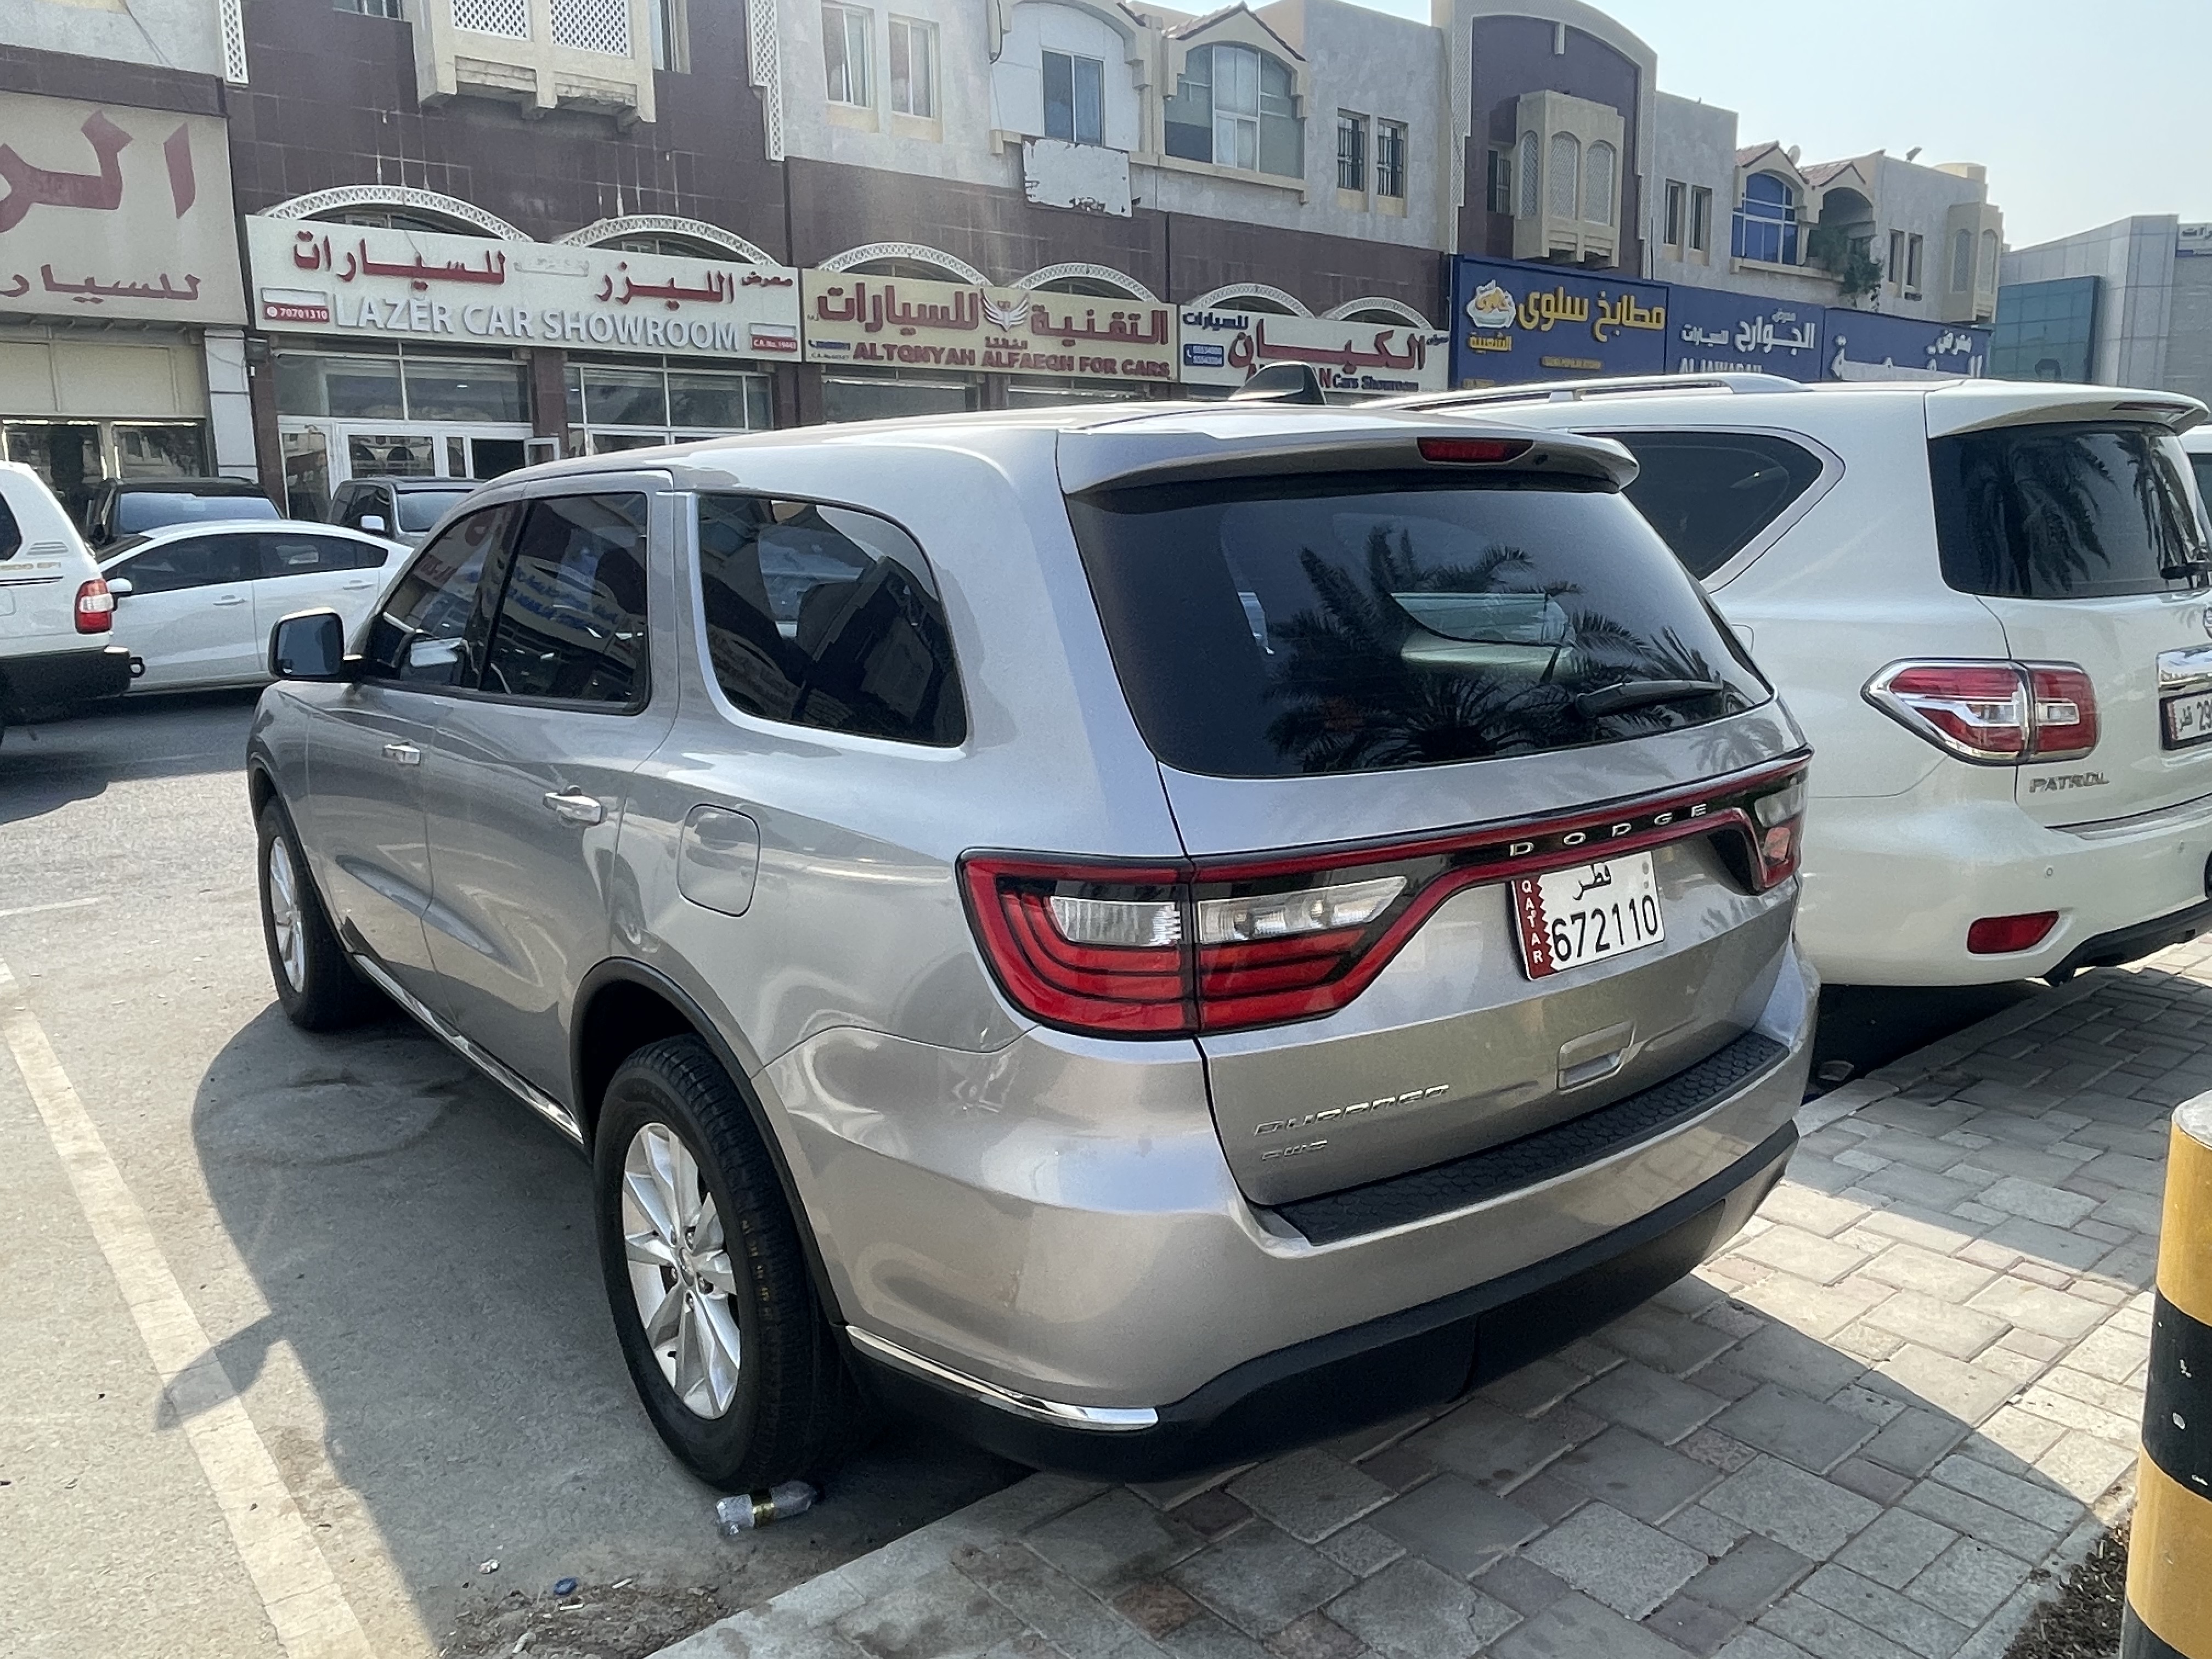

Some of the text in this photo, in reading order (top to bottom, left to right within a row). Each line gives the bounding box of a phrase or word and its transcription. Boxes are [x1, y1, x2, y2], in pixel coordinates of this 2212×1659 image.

[0, 264, 201, 304] للسيار
[293, 230, 793, 311] معرض الليزر للسيارات
[280, 307, 328, 320] 70701310
[334, 293, 740, 352] LAZER CAR SHOWROOM
[817, 282, 1169, 347] التقنية للسيارات
[1183, 312, 1249, 331] للسيارات
[1518, 286, 1589, 331] سلوى
[1593, 290, 1666, 342] مطابخ
[1228, 318, 1425, 375] الكيان
[1734, 315, 1816, 356] الجوارح
[1079, 357, 1118, 374] FOR
[1121, 358, 1170, 377] CARS
[1333, 373, 1359, 388] Cars
[2029, 770, 2110, 793] PATROL
[1510, 803, 1707, 857] DODGE
[1521, 879, 1544, 964] QATAR
[1550, 894, 1660, 962] 672110
